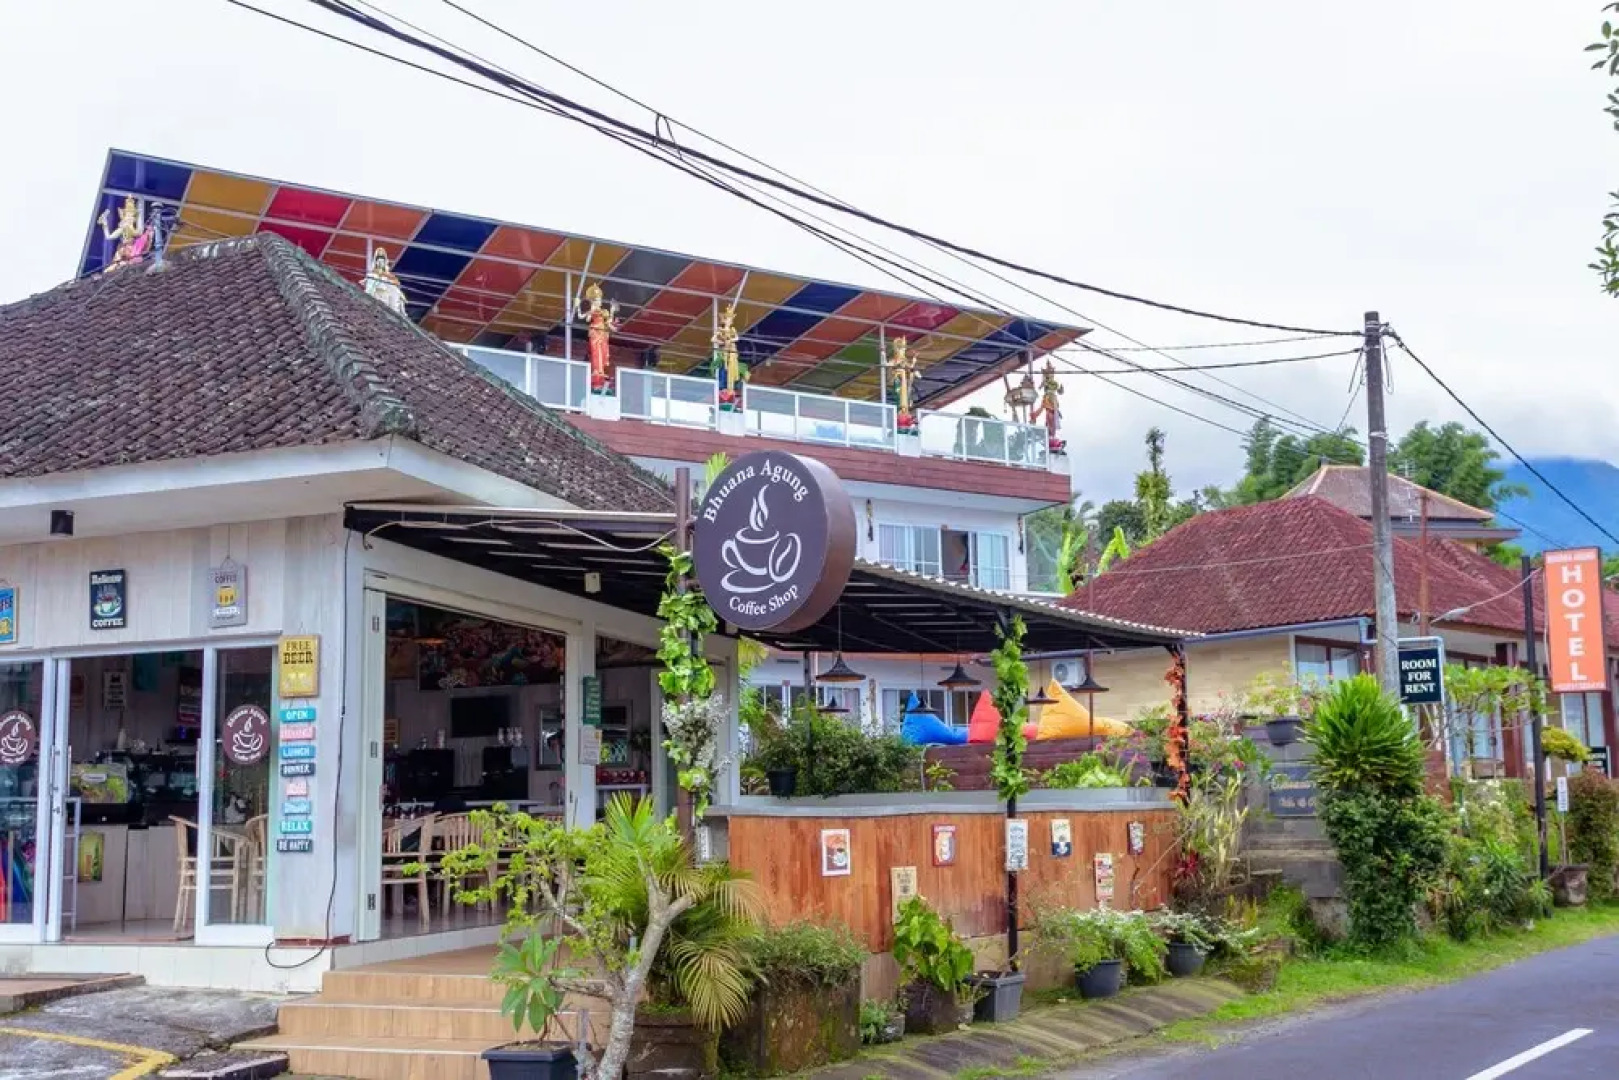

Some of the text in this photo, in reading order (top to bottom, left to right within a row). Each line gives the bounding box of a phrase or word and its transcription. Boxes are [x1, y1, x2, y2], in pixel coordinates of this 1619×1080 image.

[703, 459, 809, 523] Bhuana Agung
[729, 584, 798, 616] Coffee Shop
[1562, 564, 1588, 681] HOTEL
[286, 640, 312, 651] FREE
[283, 651, 314, 664] BEER
[1402, 659, 1436, 670] ROOM
[1408, 671, 1432, 681] FOR
[1405, 682, 1436, 693] RENT
[286, 710, 309, 720] OPEN
[282, 747, 310, 757] LUNCH
[281, 820, 310, 831] RELAX
[279, 840, 310, 850] BE HAPPY
